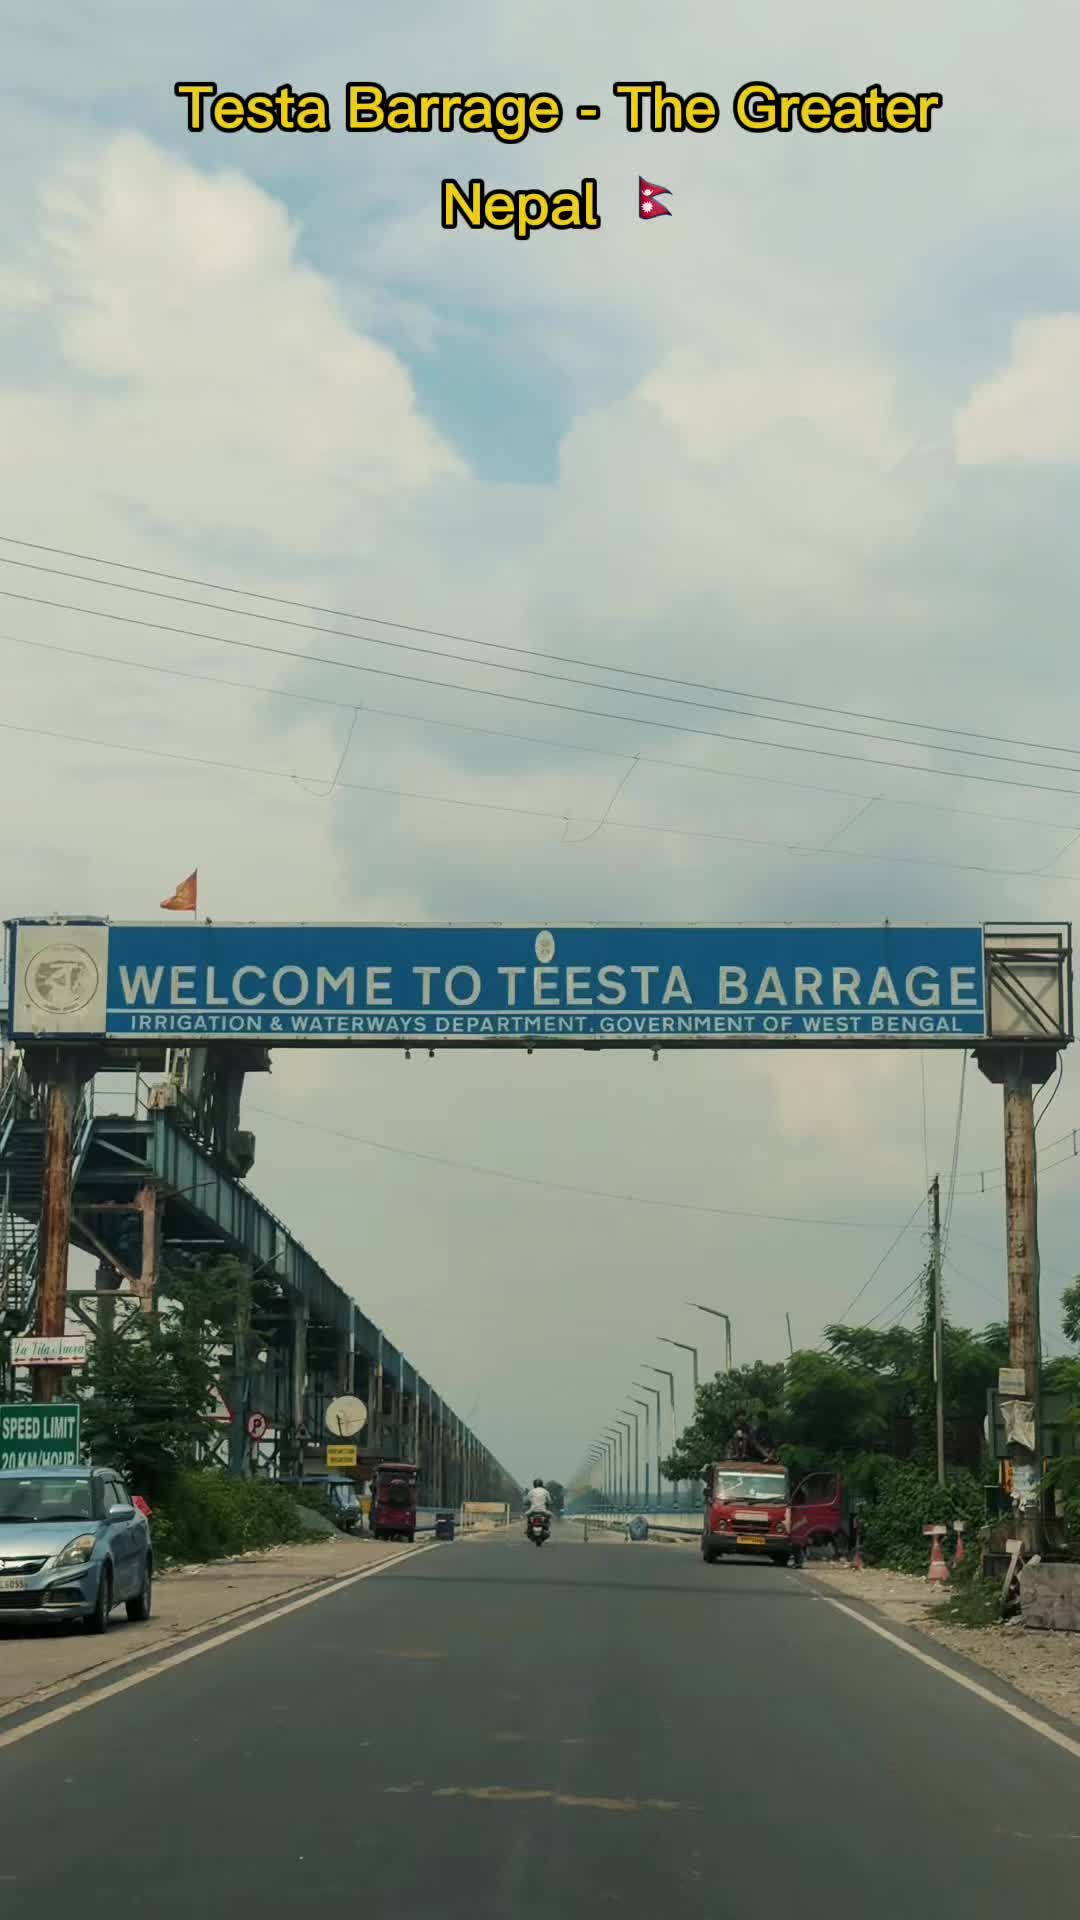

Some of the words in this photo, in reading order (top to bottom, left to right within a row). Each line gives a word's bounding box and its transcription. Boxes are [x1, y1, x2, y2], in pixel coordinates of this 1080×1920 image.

[118, 965, 393, 1006] WELCOME
[412, 965, 481, 1006] TO
[497, 965, 692, 1006] TEESTA
[718, 965, 977, 1007] BARRAGE
[131, 1014, 262, 1031] IRRIGATION
[270, 1015, 283, 1031] &
[291, 1015, 426, 1032] WATERWAYS
[763, 1016, 792, 1032] OF
[802, 1016, 861, 1033] WEST
[871, 1015, 962, 1032] BENGAL
[2, 1417, 40, 1440] SPEED
[43, 1416, 75, 1439] LIMIT
[2, 1451, 16, 1469] 20
